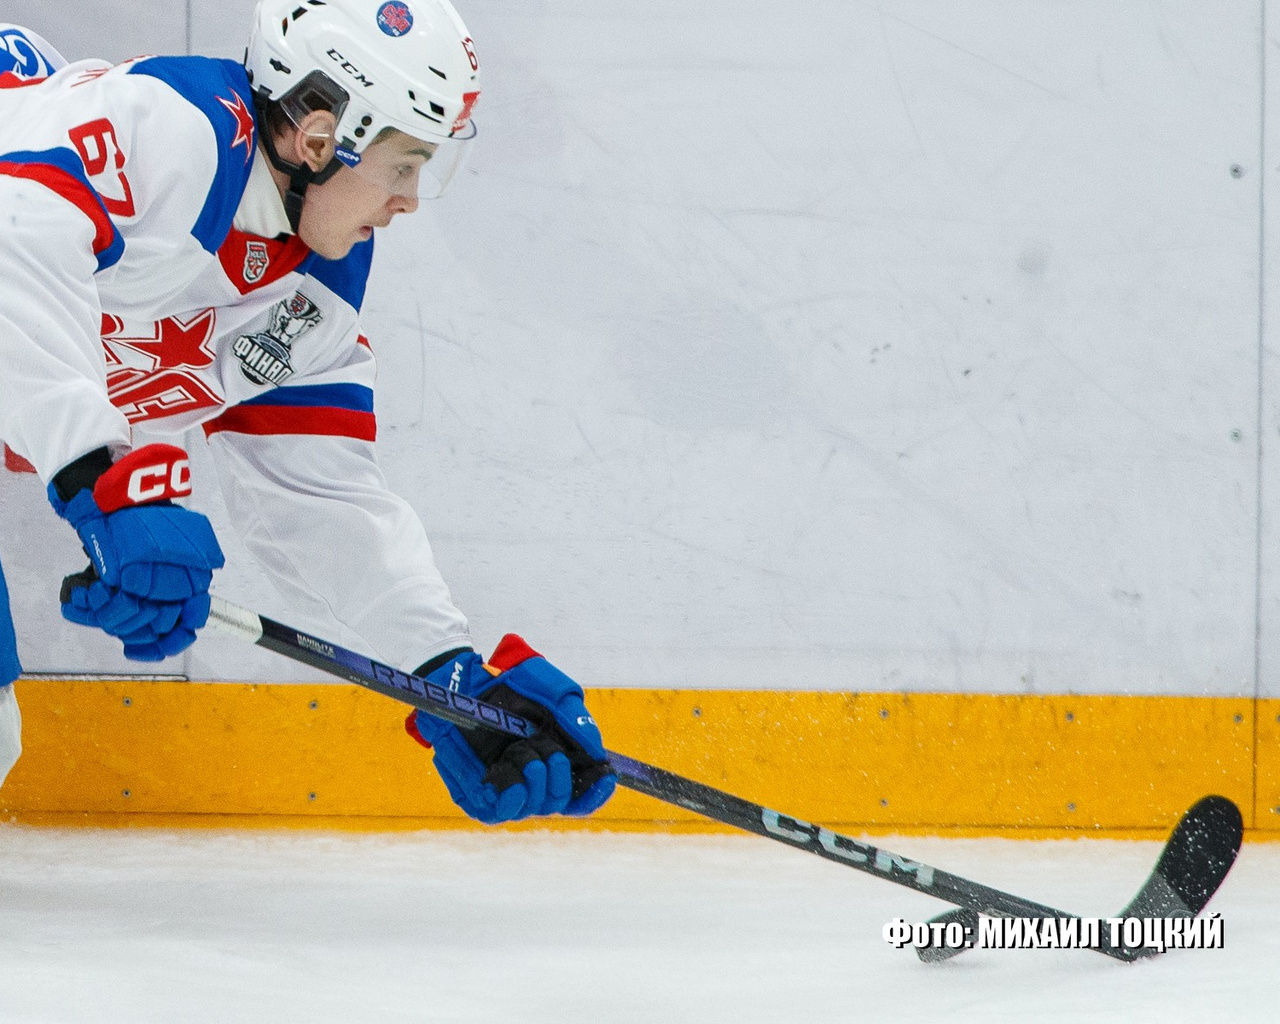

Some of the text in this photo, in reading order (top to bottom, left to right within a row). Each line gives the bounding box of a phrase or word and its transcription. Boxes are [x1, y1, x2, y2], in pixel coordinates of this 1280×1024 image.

[326, 48, 375, 88] CCM
[68, 117, 136, 218] 67
[334, 149, 360, 162] CCM
[233, 337, 294, 384] ФИНАЛ
[371, 659, 528, 737] RIBCOR
[761, 806, 935, 886] CCM
